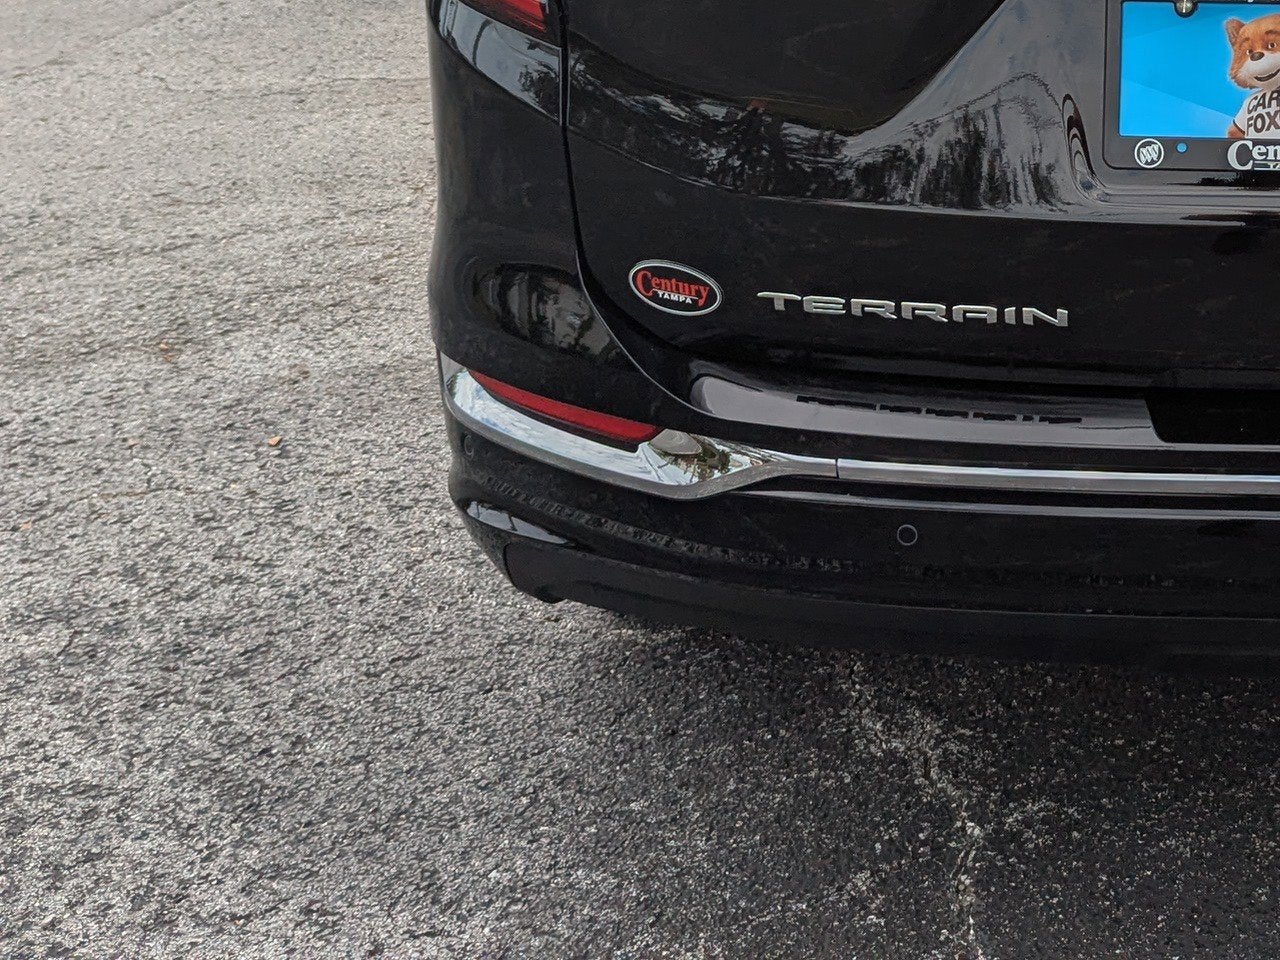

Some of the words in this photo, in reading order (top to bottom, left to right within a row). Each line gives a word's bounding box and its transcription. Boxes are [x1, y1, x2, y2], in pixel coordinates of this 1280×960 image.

[1246, 90, 1280, 115] CAR
[635, 270, 710, 307] Century
[658, 290, 692, 304] TAMPA
[757, 291, 1069, 327] TERRAIN
